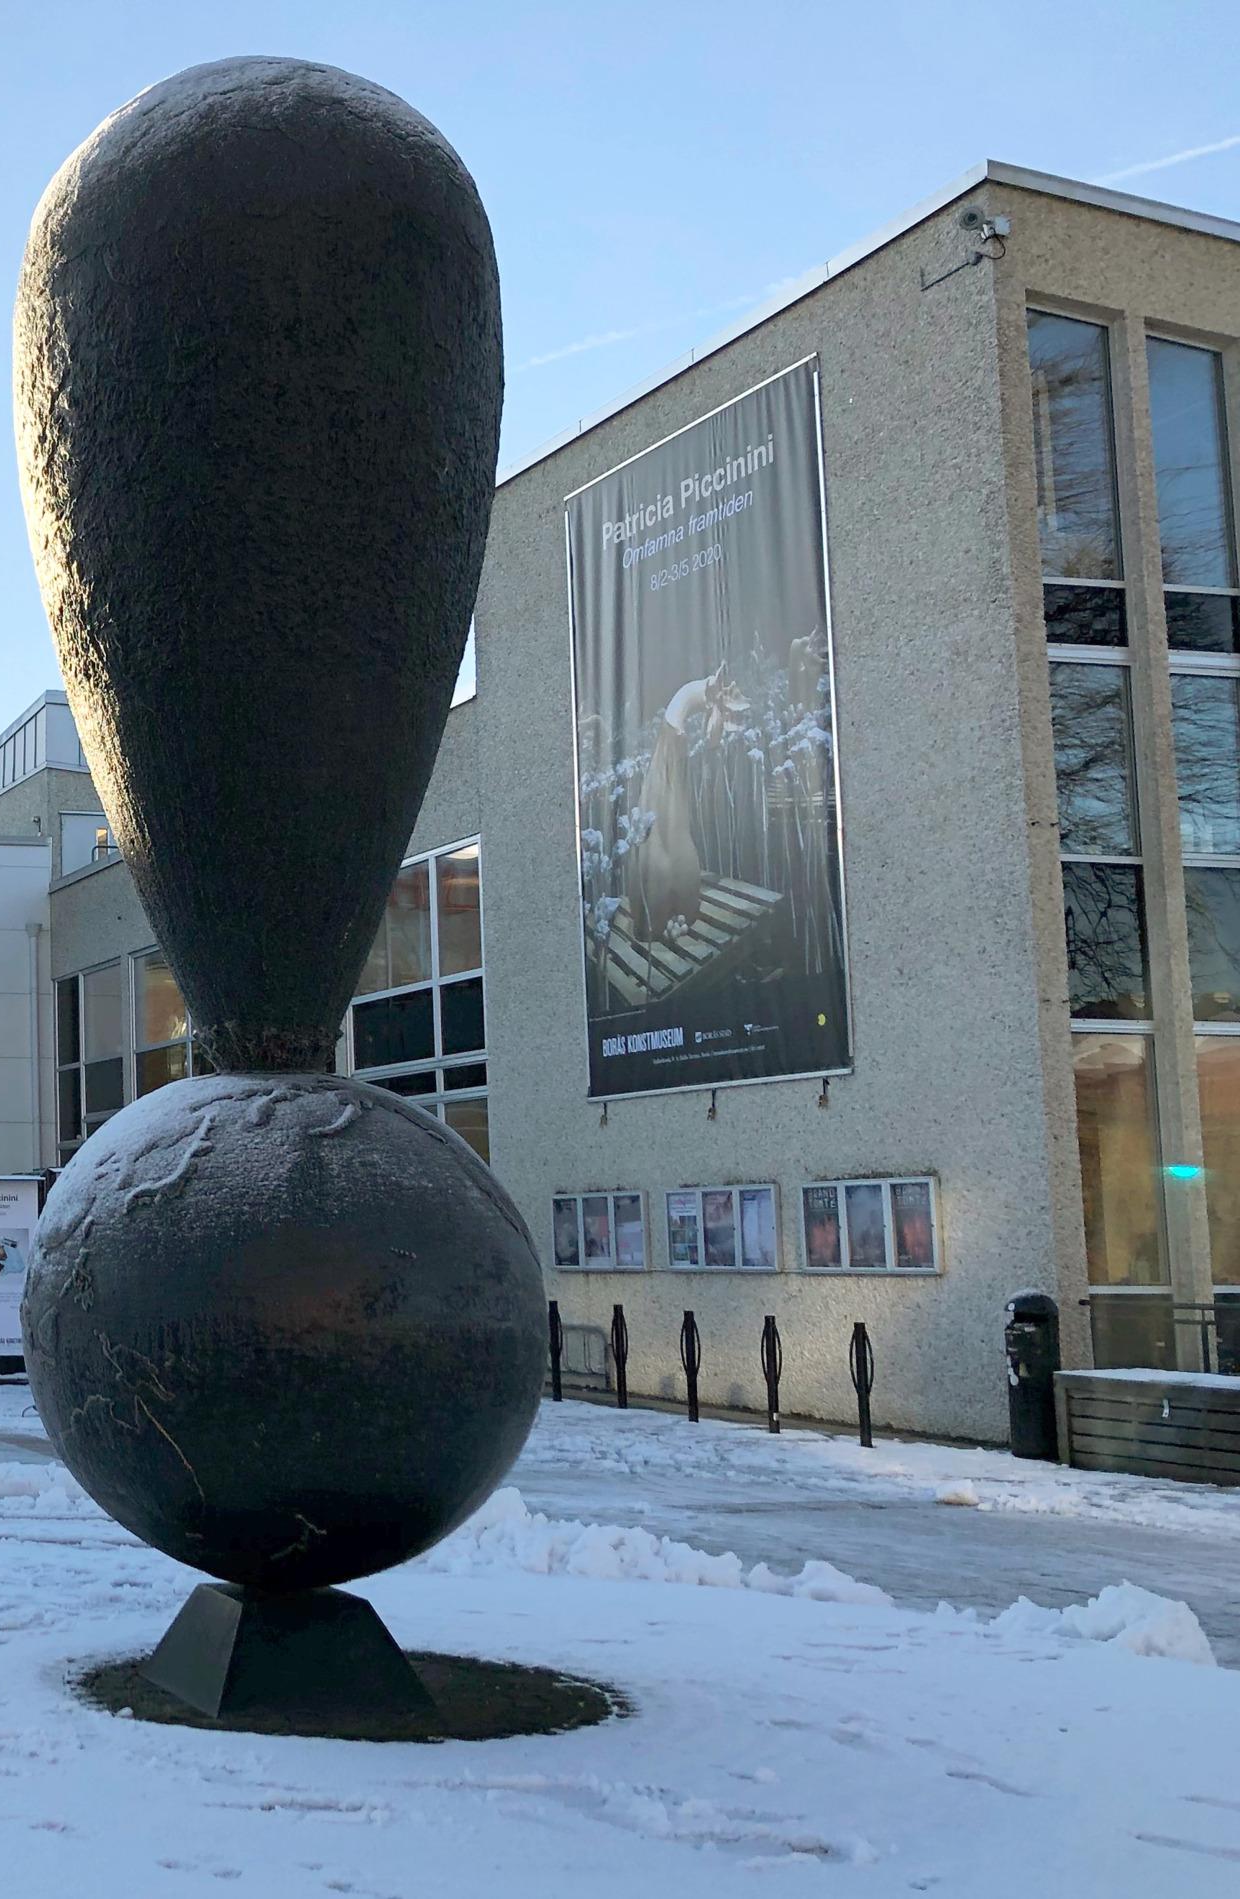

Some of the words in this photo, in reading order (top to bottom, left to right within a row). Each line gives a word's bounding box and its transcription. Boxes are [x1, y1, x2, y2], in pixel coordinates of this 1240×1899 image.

[602, 494, 674, 551] Patricia
[680, 433, 775, 509] Piccinini
[622, 525, 685, 569] Omfamna
[688, 490, 753, 536] framtiden
[650, 558, 690, 592] 8/2-3/5
[692, 543, 723, 572] 2020
[602, 1034, 626, 1057] BORÅS
[627, 1027, 684, 1053] KONSTMUSEUM
